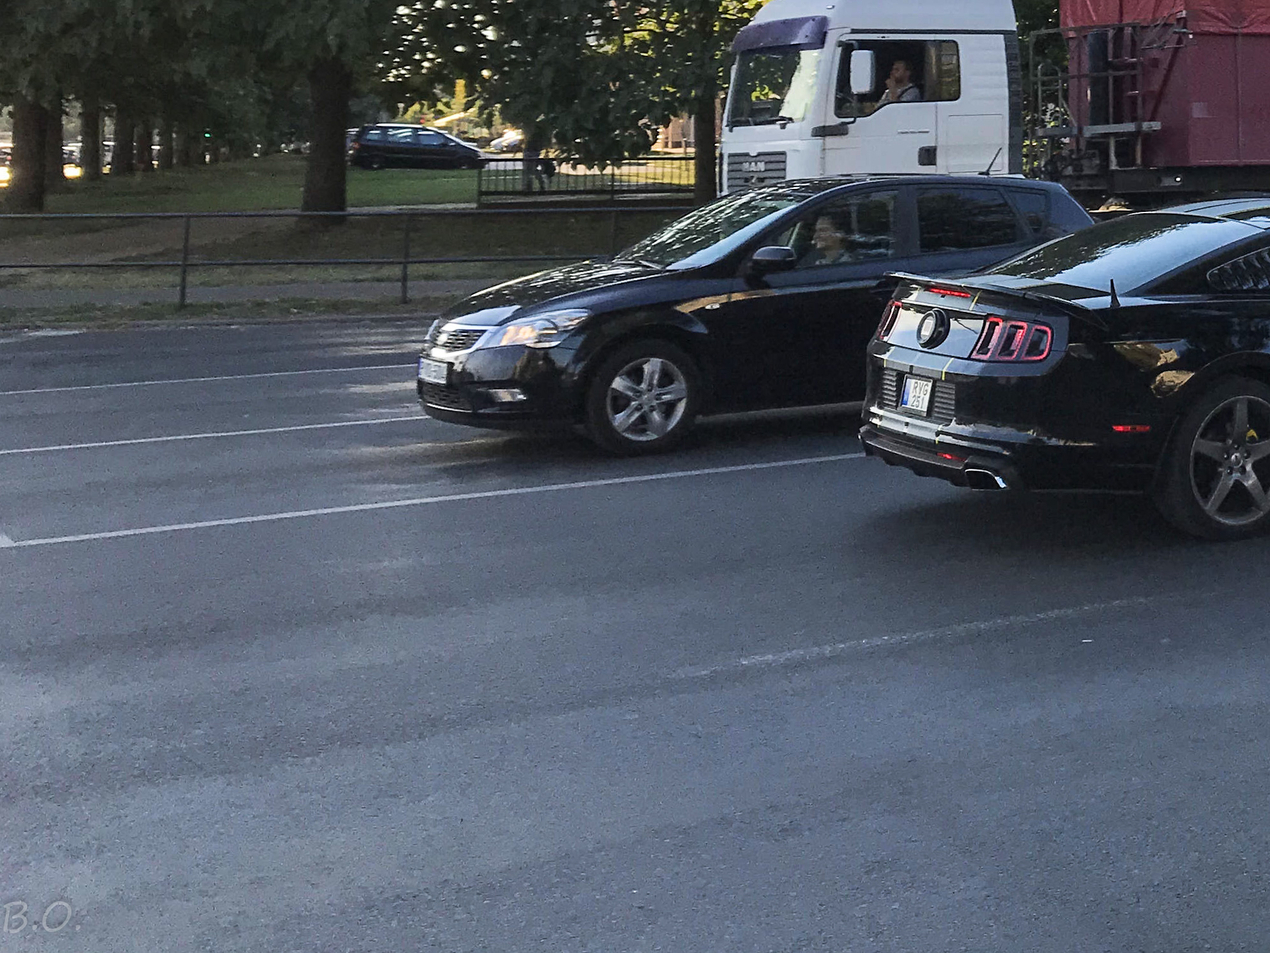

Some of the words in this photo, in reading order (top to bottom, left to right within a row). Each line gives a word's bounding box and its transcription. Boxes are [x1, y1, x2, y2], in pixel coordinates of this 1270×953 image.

[742, 161, 765, 172] MAN
[912, 381, 929, 396] RVG
[910, 394, 925, 409] 251
